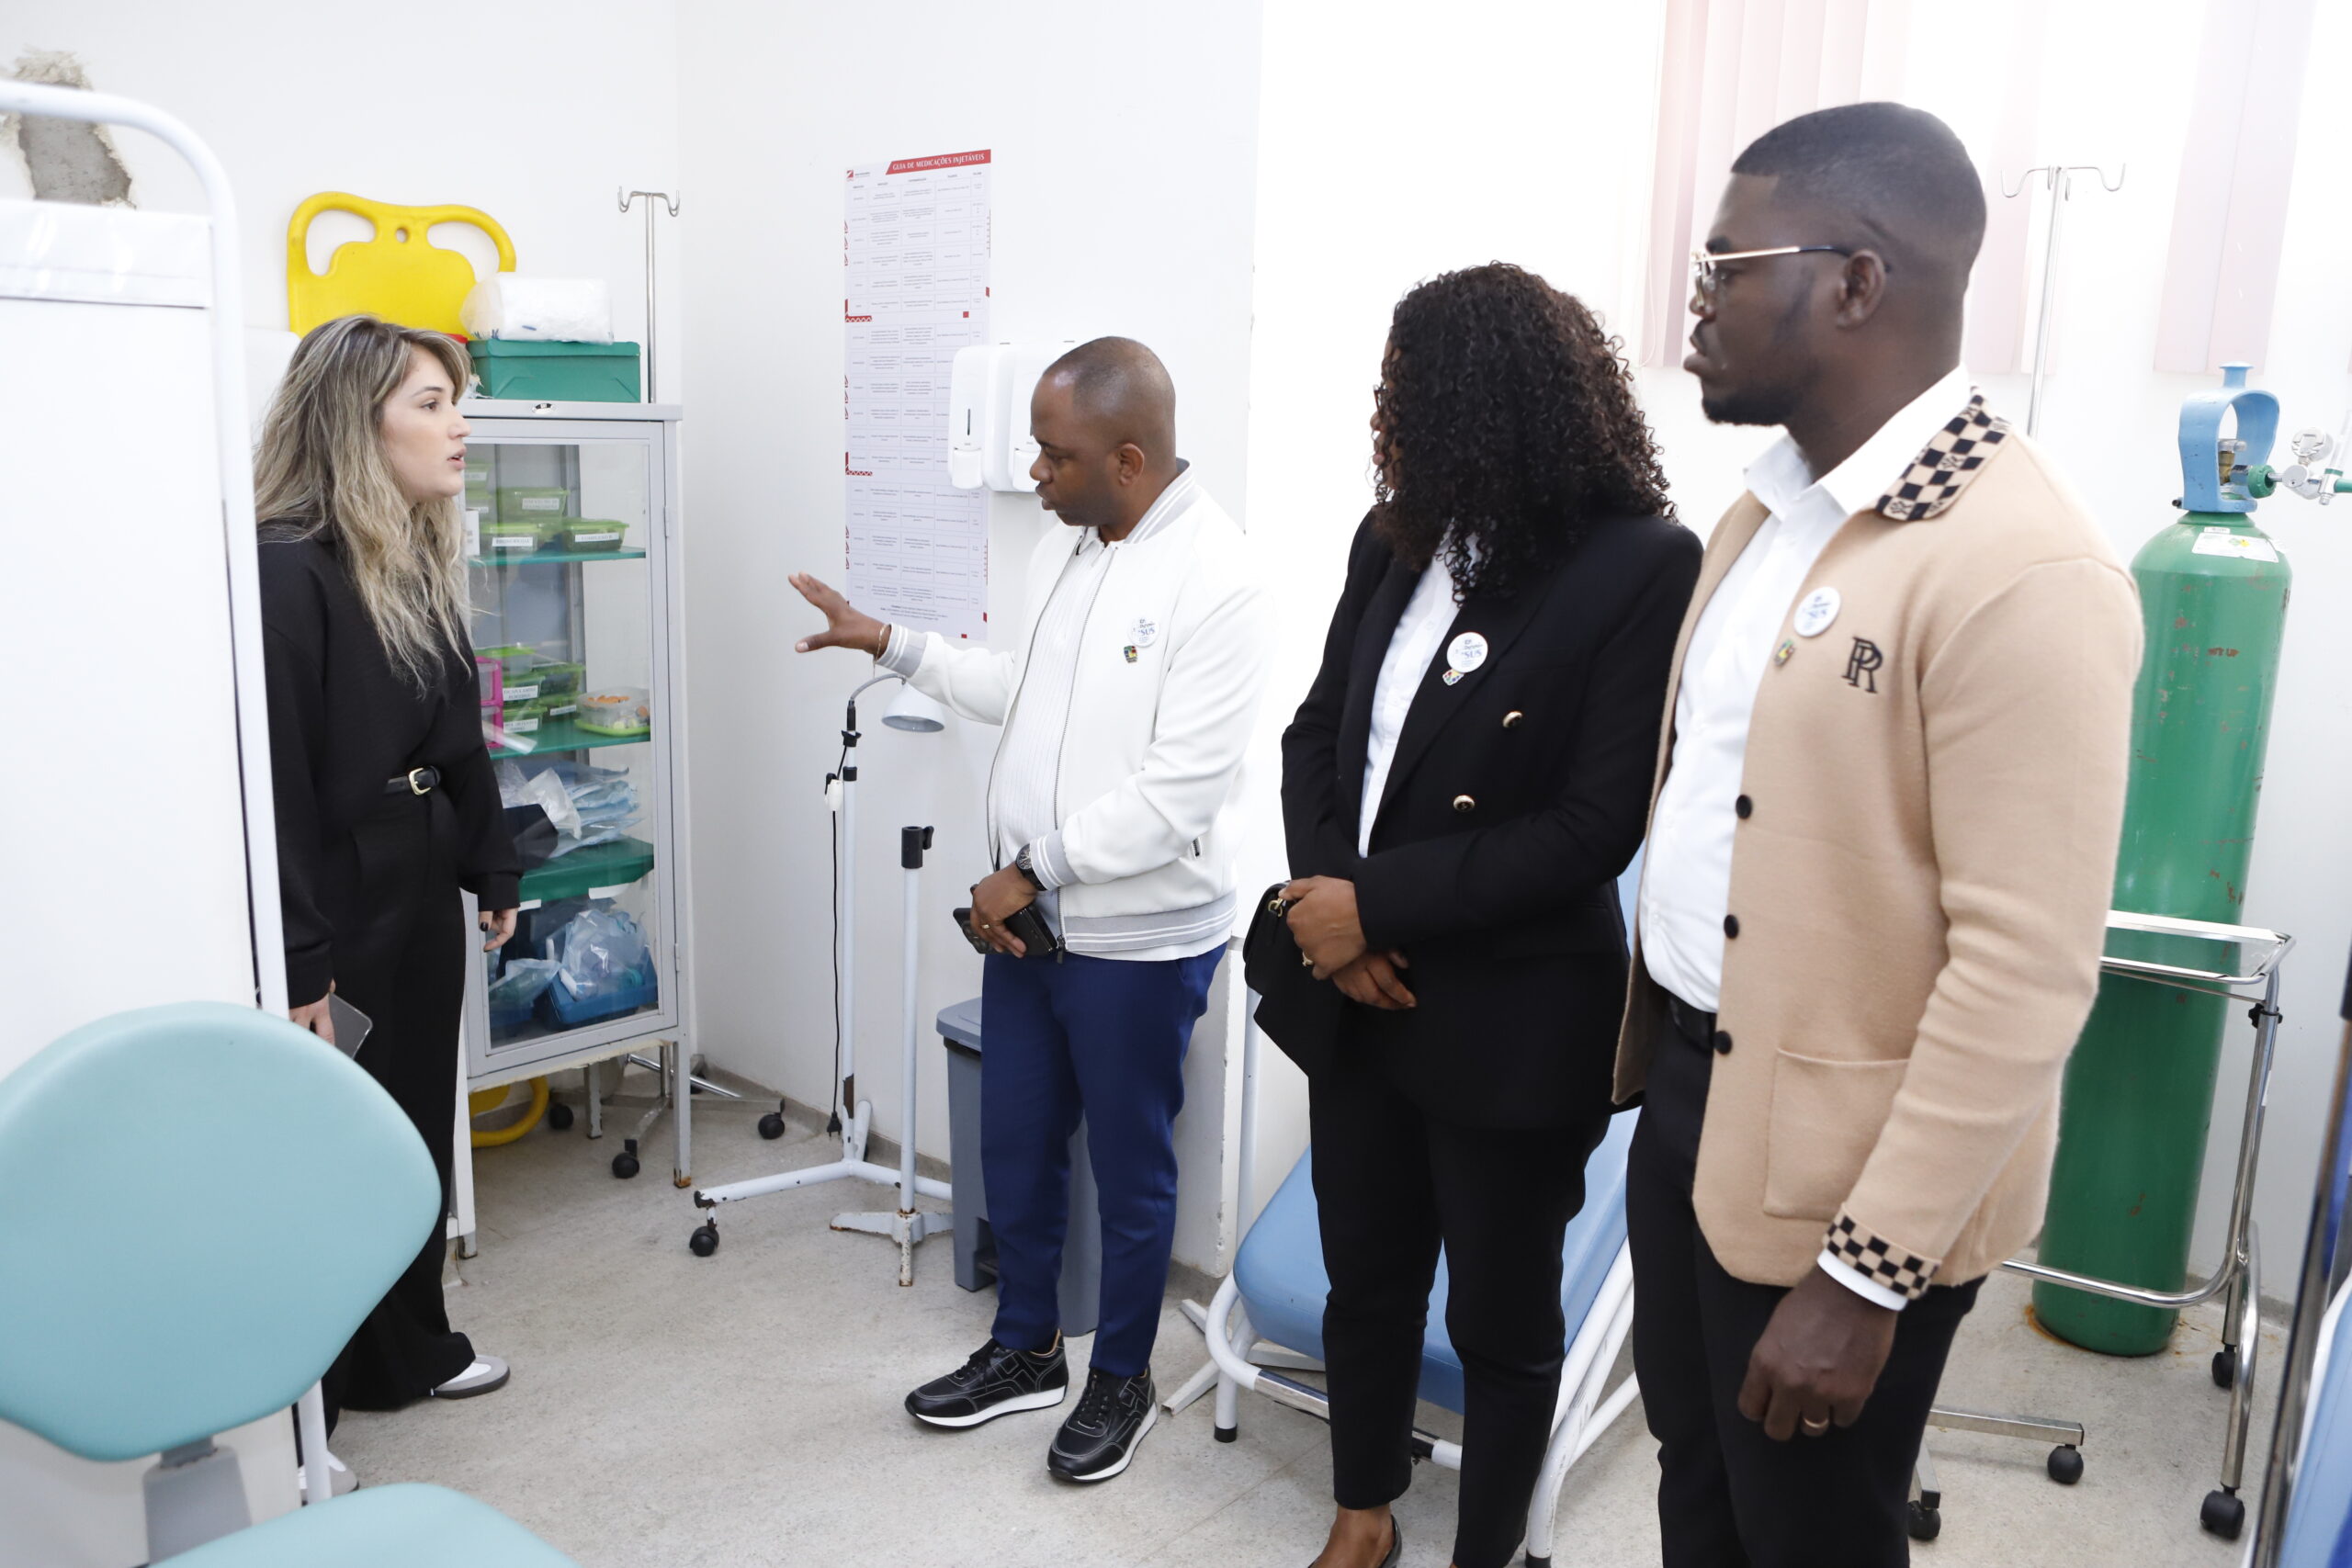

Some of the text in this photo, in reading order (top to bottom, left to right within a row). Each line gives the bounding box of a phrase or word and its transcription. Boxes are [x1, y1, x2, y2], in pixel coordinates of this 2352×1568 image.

[892, 163, 906, 171] GUIA
[916, 157, 952, 168] MEDICAÇÕES
[953, 152, 985, 165] INJETÁVEIS
